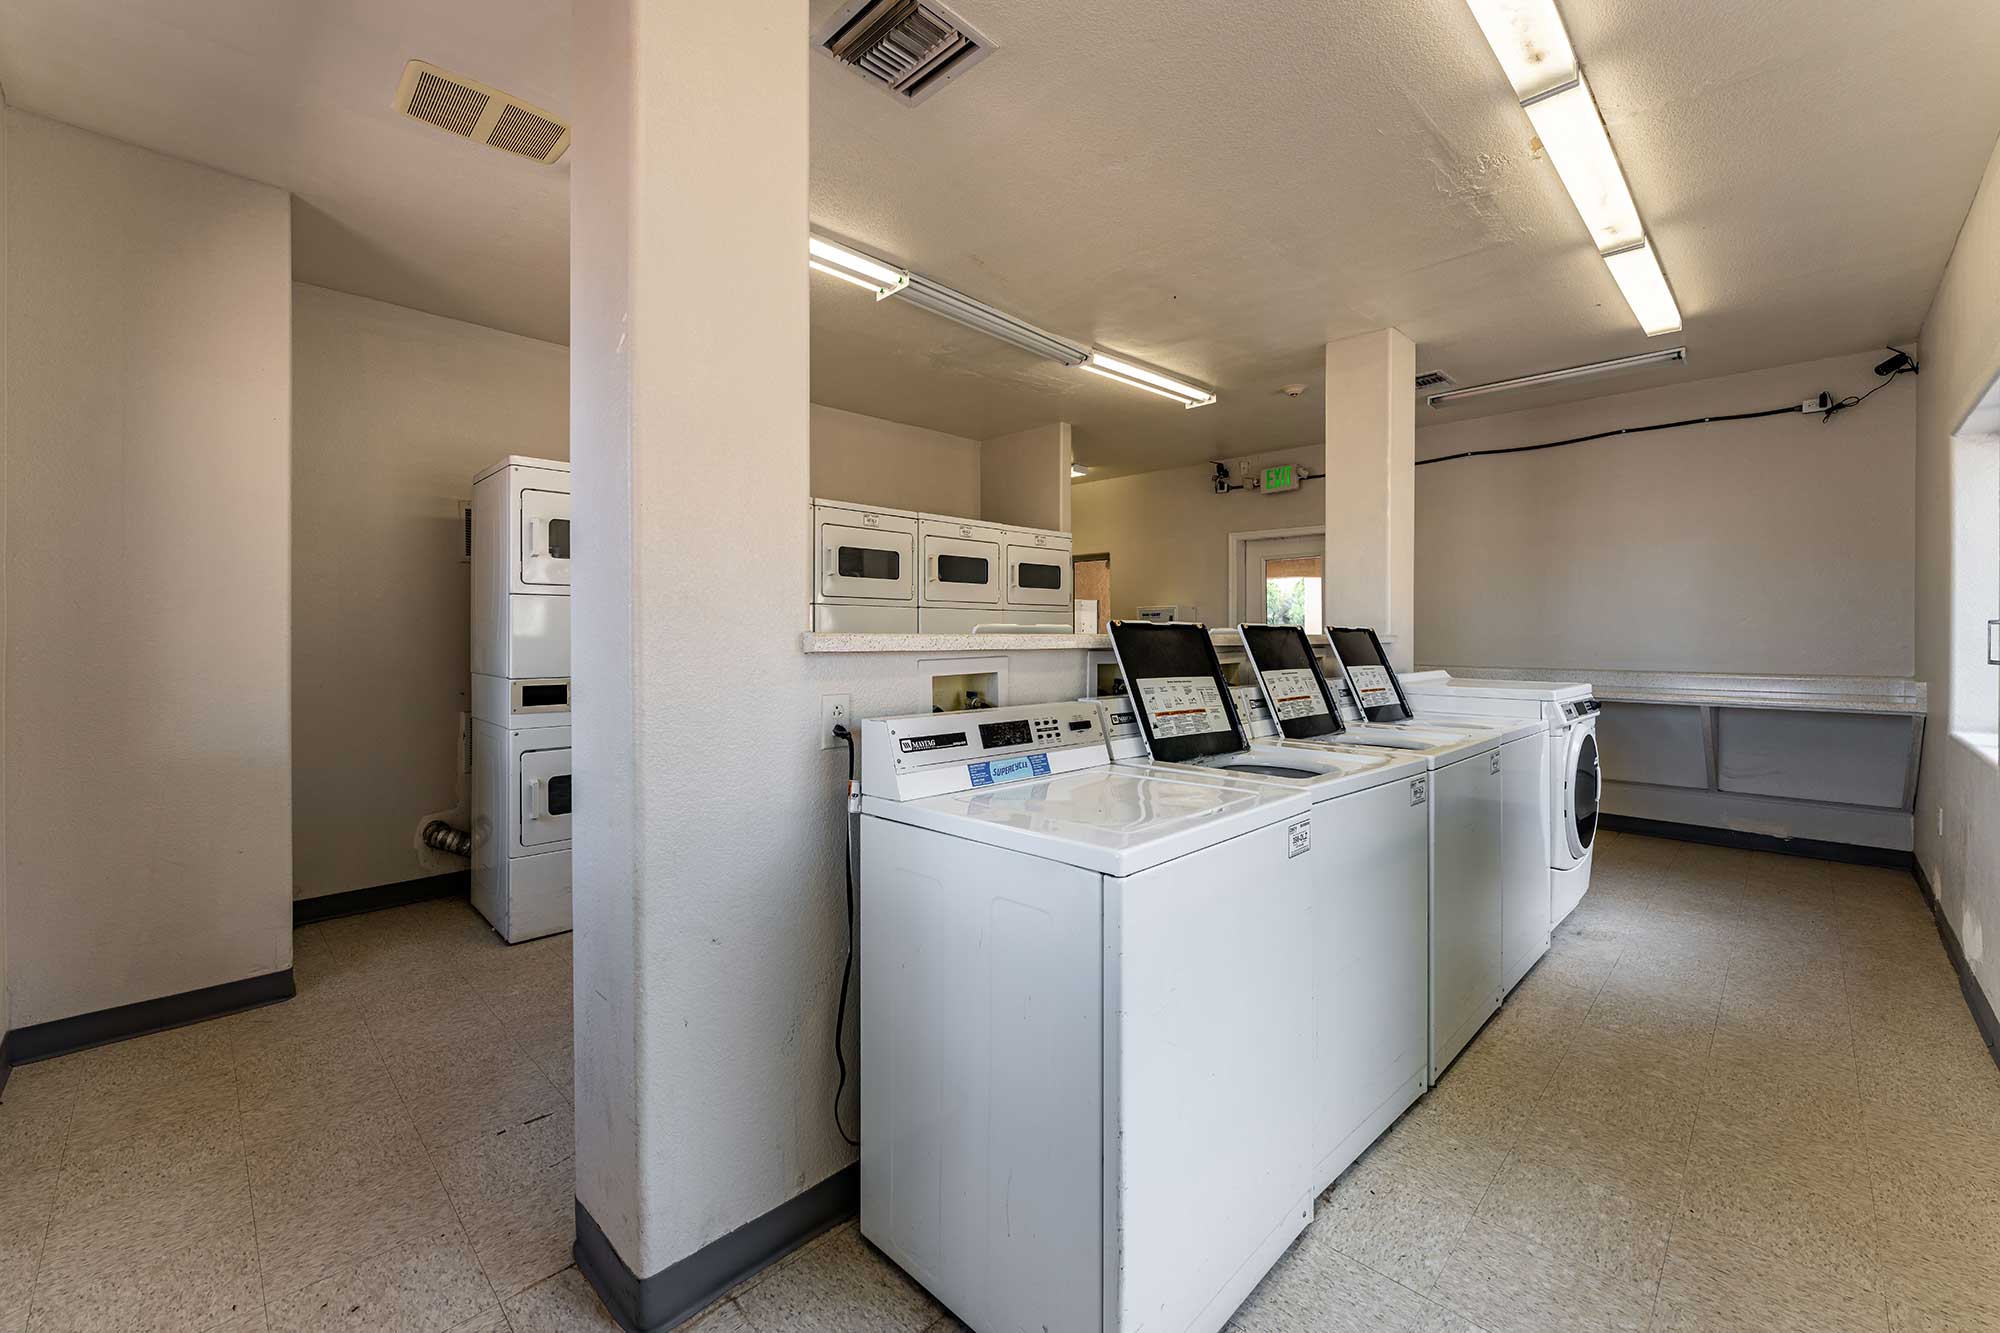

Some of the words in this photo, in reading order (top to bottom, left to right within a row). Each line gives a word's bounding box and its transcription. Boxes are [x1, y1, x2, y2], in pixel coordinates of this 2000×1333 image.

[1265, 465, 1292, 490] EXIT
[911, 739, 936, 748] MAYTAG
[992, 761, 1029, 777] SUPERCYCLE
